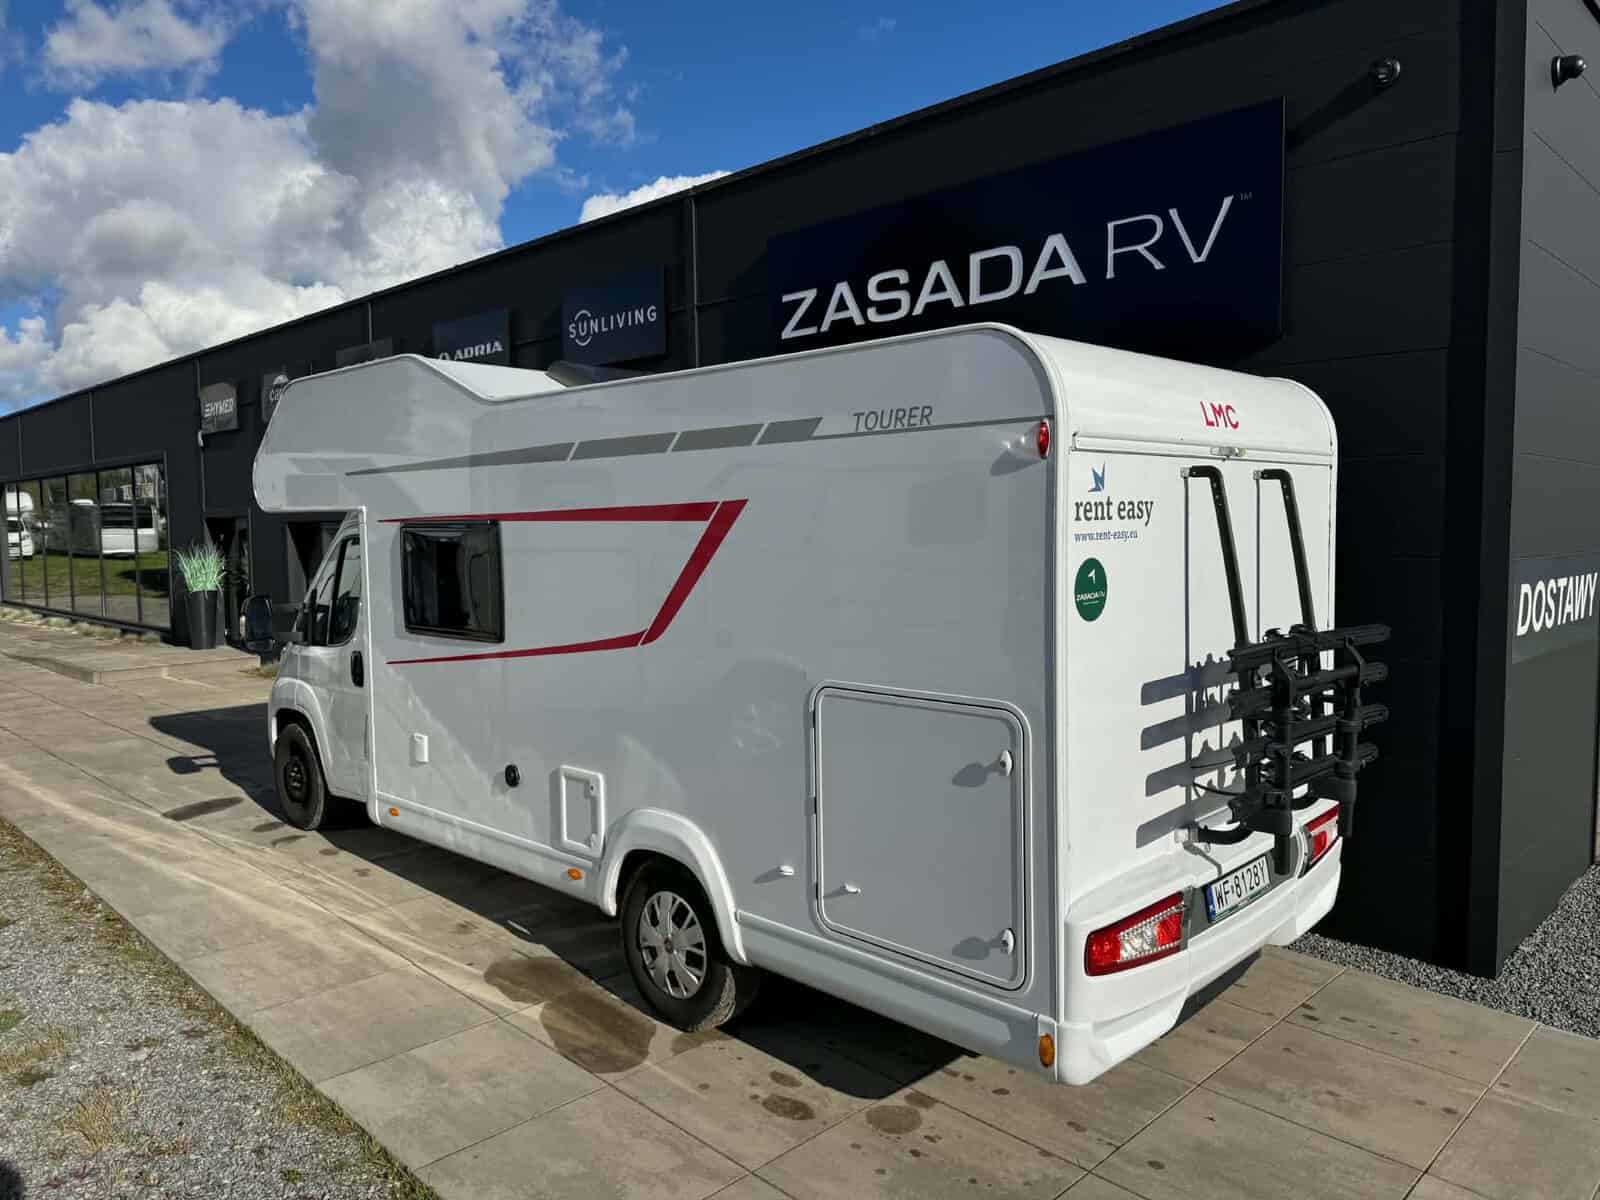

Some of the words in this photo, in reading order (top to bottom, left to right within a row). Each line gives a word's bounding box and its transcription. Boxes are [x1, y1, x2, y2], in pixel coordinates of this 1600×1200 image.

[781, 233, 1087, 339] ZASADA
[1105, 195, 1235, 279] RV
[568, 306, 657, 339] SUNLIVING
[454, 340, 504, 361] ADRIA
[853, 405, 934, 433] TOURER
[1200, 401, 1239, 430] LMC
[1074, 496, 1113, 521] rent
[1117, 500, 1154, 527] easy
[1074, 529, 1138, 542] www.rent-easy.eu
[1516, 572, 1598, 636] DOSTAWY
[1214, 880, 1230, 910] WF
[1234, 860, 1266, 898] 8128Y
